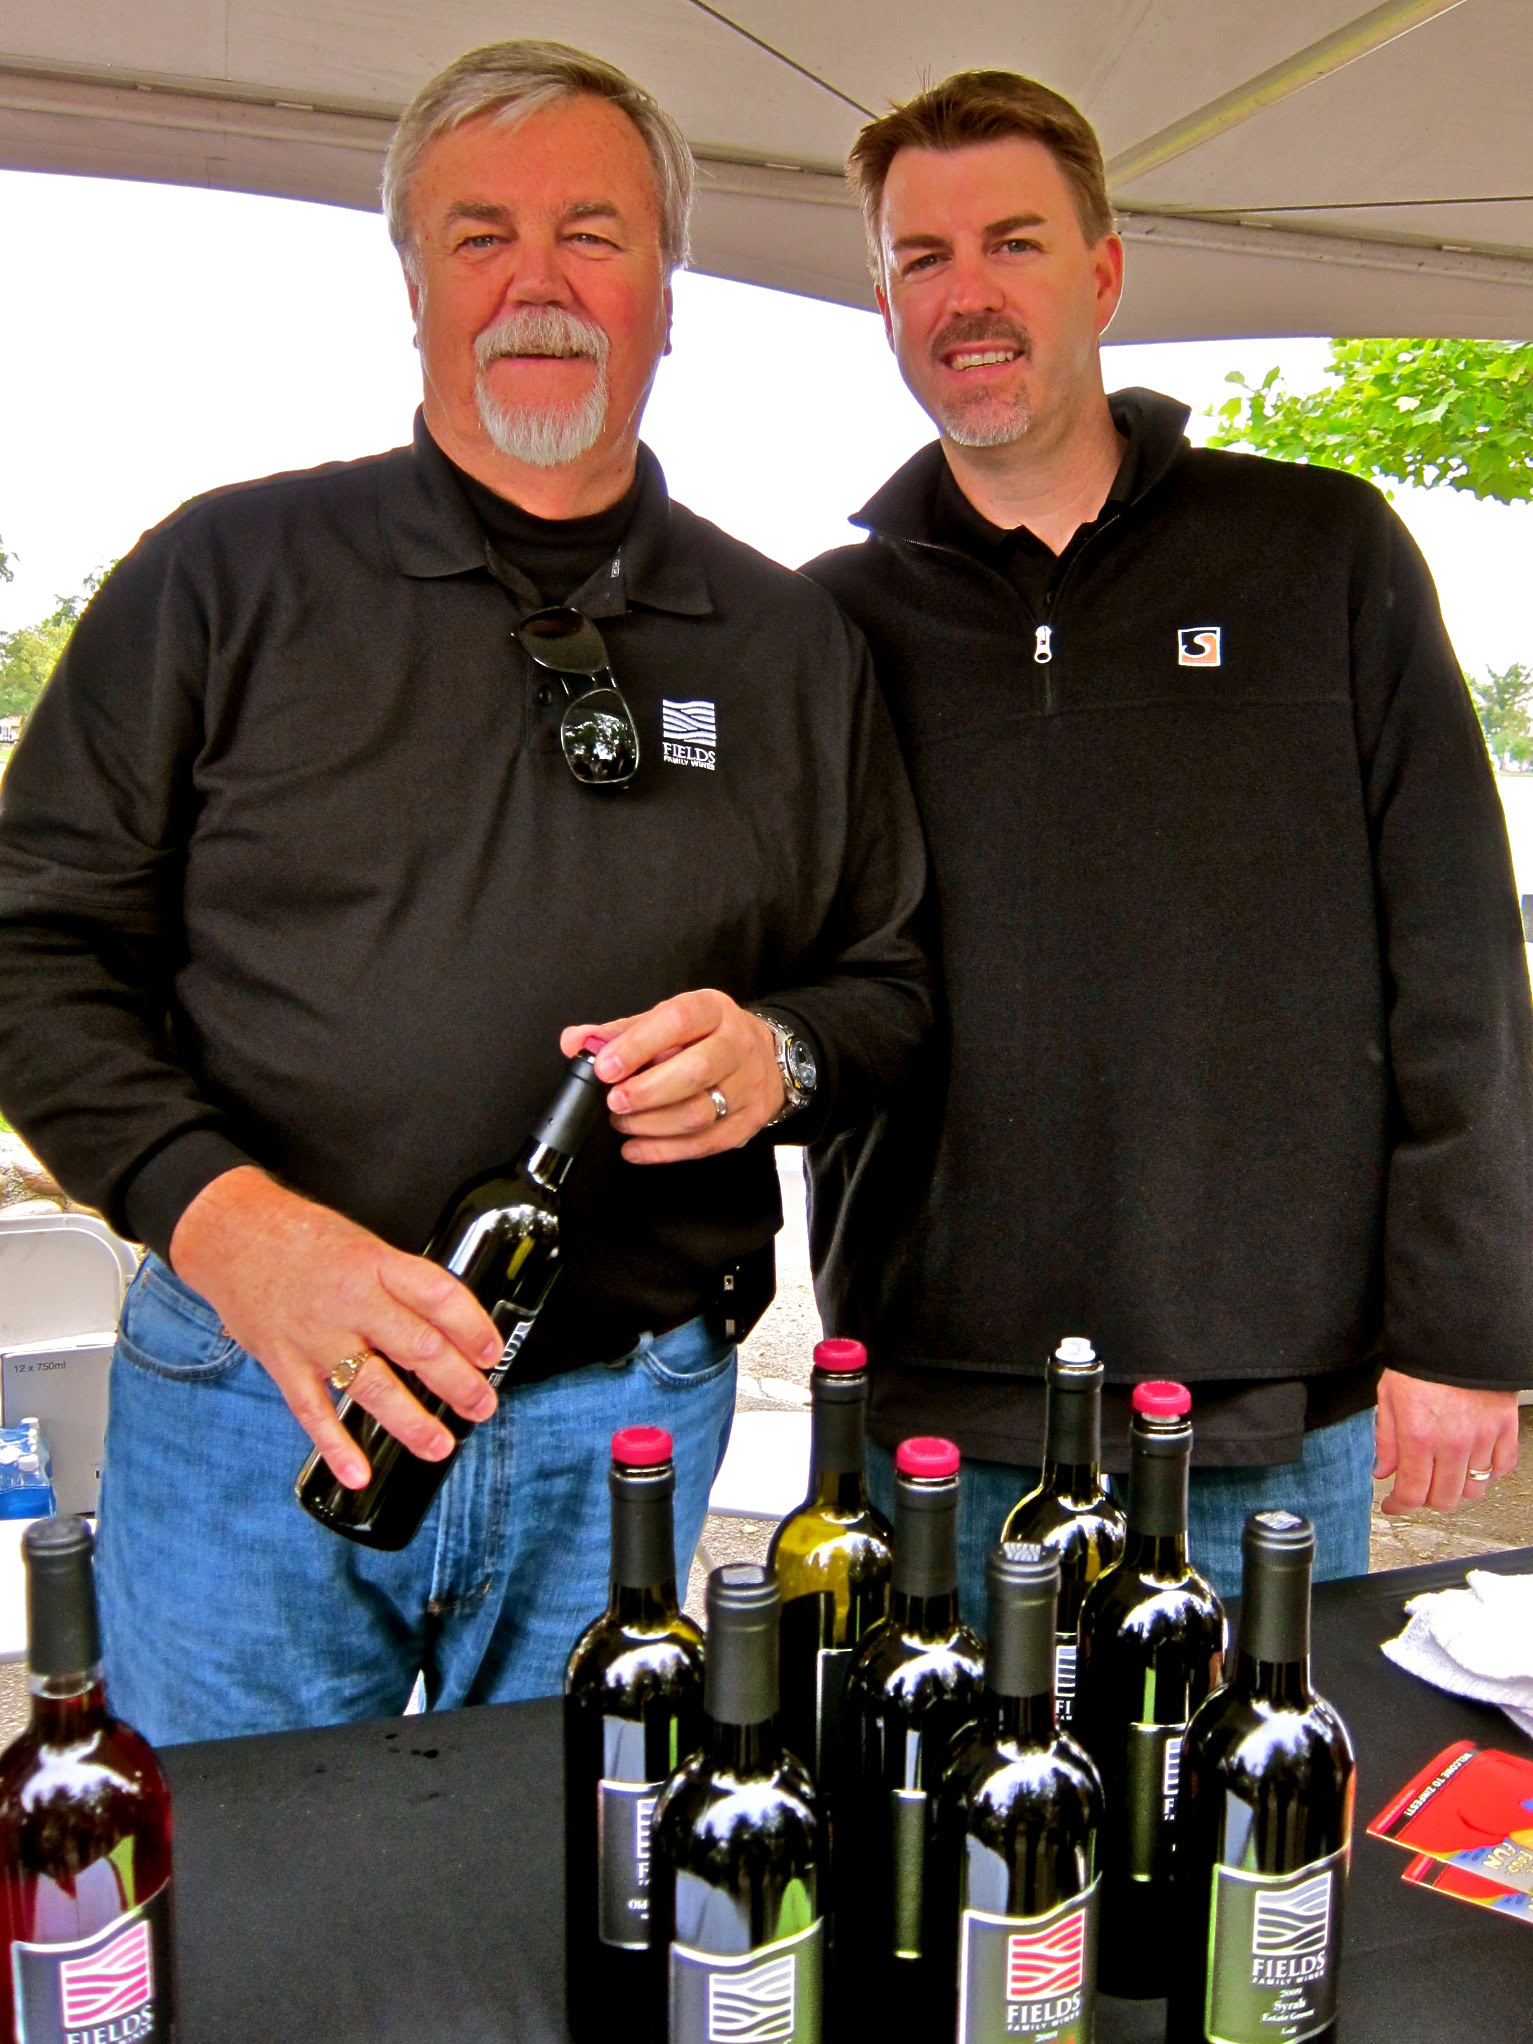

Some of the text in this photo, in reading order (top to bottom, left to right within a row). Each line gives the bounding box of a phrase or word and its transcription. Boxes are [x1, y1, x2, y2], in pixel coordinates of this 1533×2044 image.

[662, 742, 716, 764] FIELDS
[663, 755, 715, 771] FAMILY WINES
[13, 1364, 26, 1373] 12
[37, 1361, 66, 1372] 750ml
[1442, 1752, 1473, 1778] WELCOME
[1431, 1776, 1445, 1788] TO
[1483, 1842, 1516, 1870] FUN
[1251, 1949, 1326, 1978] FIELDS
[1251, 1969, 1325, 1985] FAMILY WINES
[1006, 1990, 1081, 2023] FIELDS
[1273, 1997, 1306, 2013] Syrah
[1006, 2022, 1047, 2031] FAMILY
